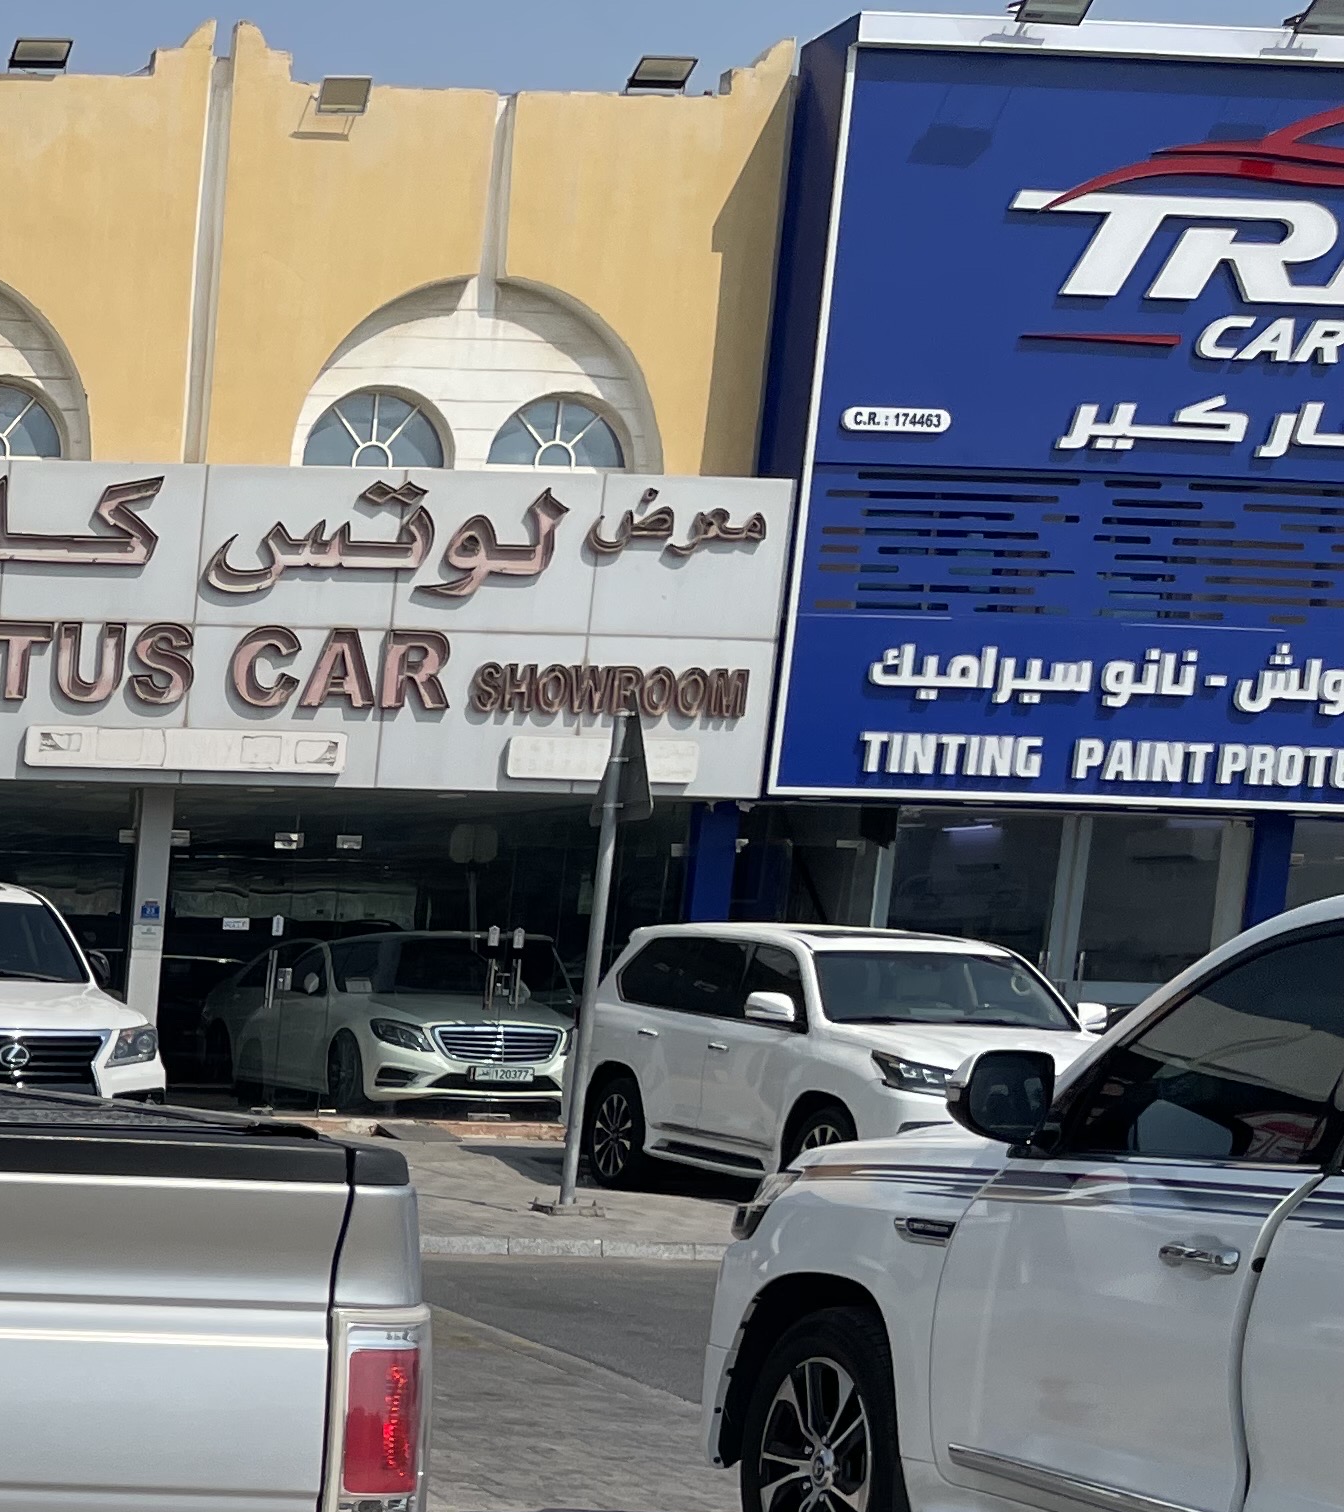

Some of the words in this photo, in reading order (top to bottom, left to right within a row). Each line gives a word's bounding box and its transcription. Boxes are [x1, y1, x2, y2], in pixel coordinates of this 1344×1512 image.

[1009, 190, 1344, 305] TR
[1196, 315, 1344, 364] CAR
[893, 411, 942, 429] 174463
[1055, 395, 1250, 450] كير
[1253, 401, 1344, 458] ار
[207, 480, 570, 597] لوتس
[586, 488, 766, 556] معرض
[233, 626, 450, 710] CAR
[475, 661, 750, 718] SHOWROOM
[869, 644, 1092, 704] سيراميك
[1101, 649, 1198, 707] نانو
[861, 731, 1043, 778] TINTING
[1072, 738, 1214, 784] PAINT
[495, 1069, 529, 1080] 120377
